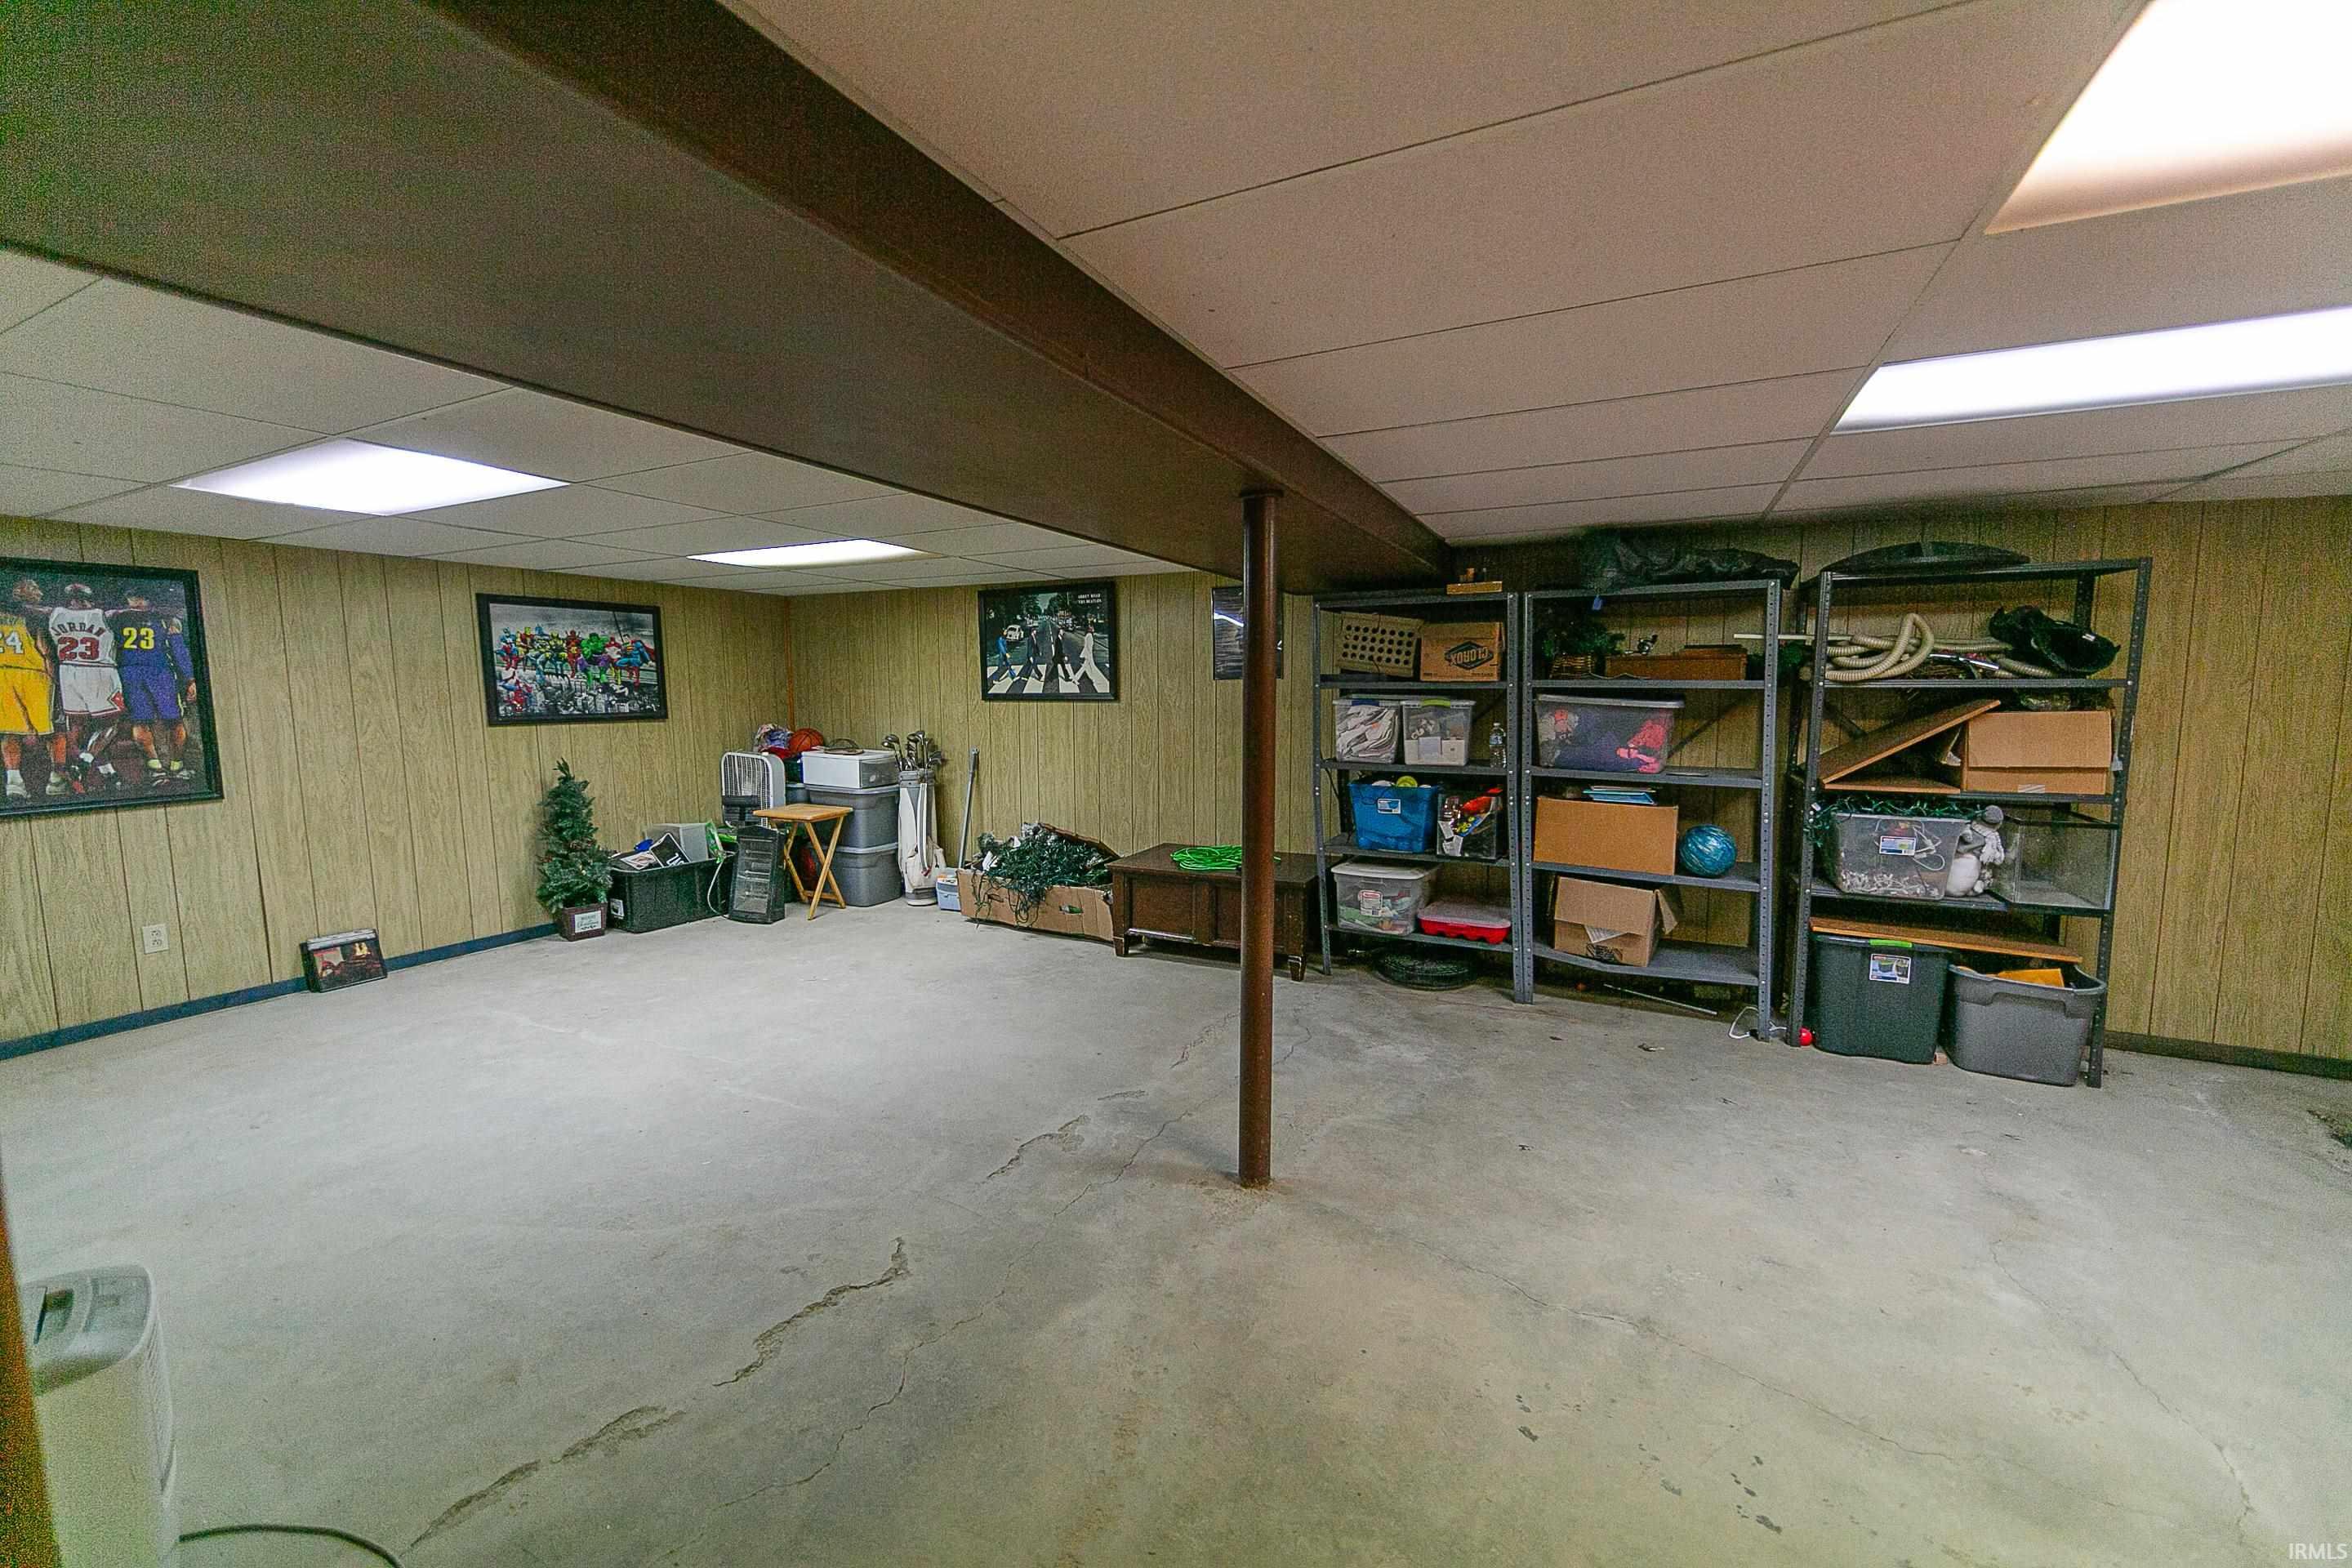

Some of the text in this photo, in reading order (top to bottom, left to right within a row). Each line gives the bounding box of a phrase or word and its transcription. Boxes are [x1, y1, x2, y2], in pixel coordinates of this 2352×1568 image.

[51, 621, 106, 637] JORDAN
[123, 627, 155, 650] 23
[0, 630, 24, 654] 4
[58, 636, 100, 661] 23
[1450, 646, 1489, 667] CLOROX
